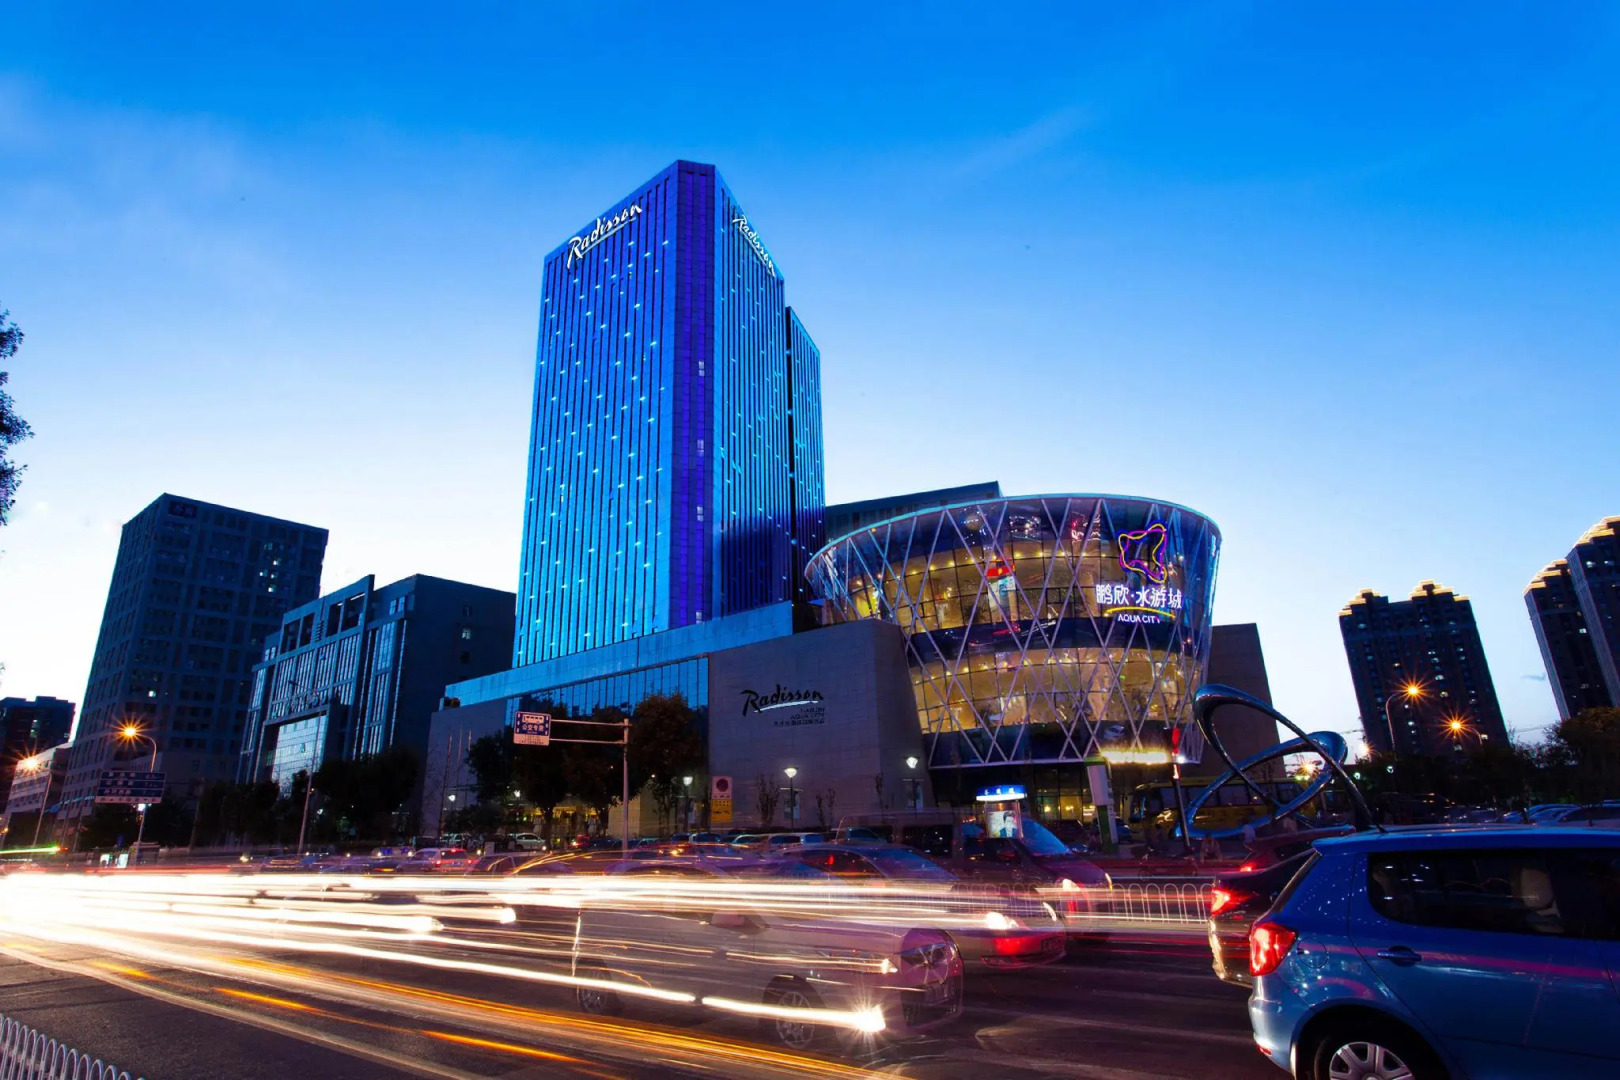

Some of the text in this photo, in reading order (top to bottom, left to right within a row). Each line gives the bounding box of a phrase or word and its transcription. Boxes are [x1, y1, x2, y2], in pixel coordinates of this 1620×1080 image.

[567, 204, 643, 269] Radisson
[732, 214, 776, 277] Radisson
[1118, 614, 1161, 624] AQUA CITY
[740, 684, 824, 717] Radisson
